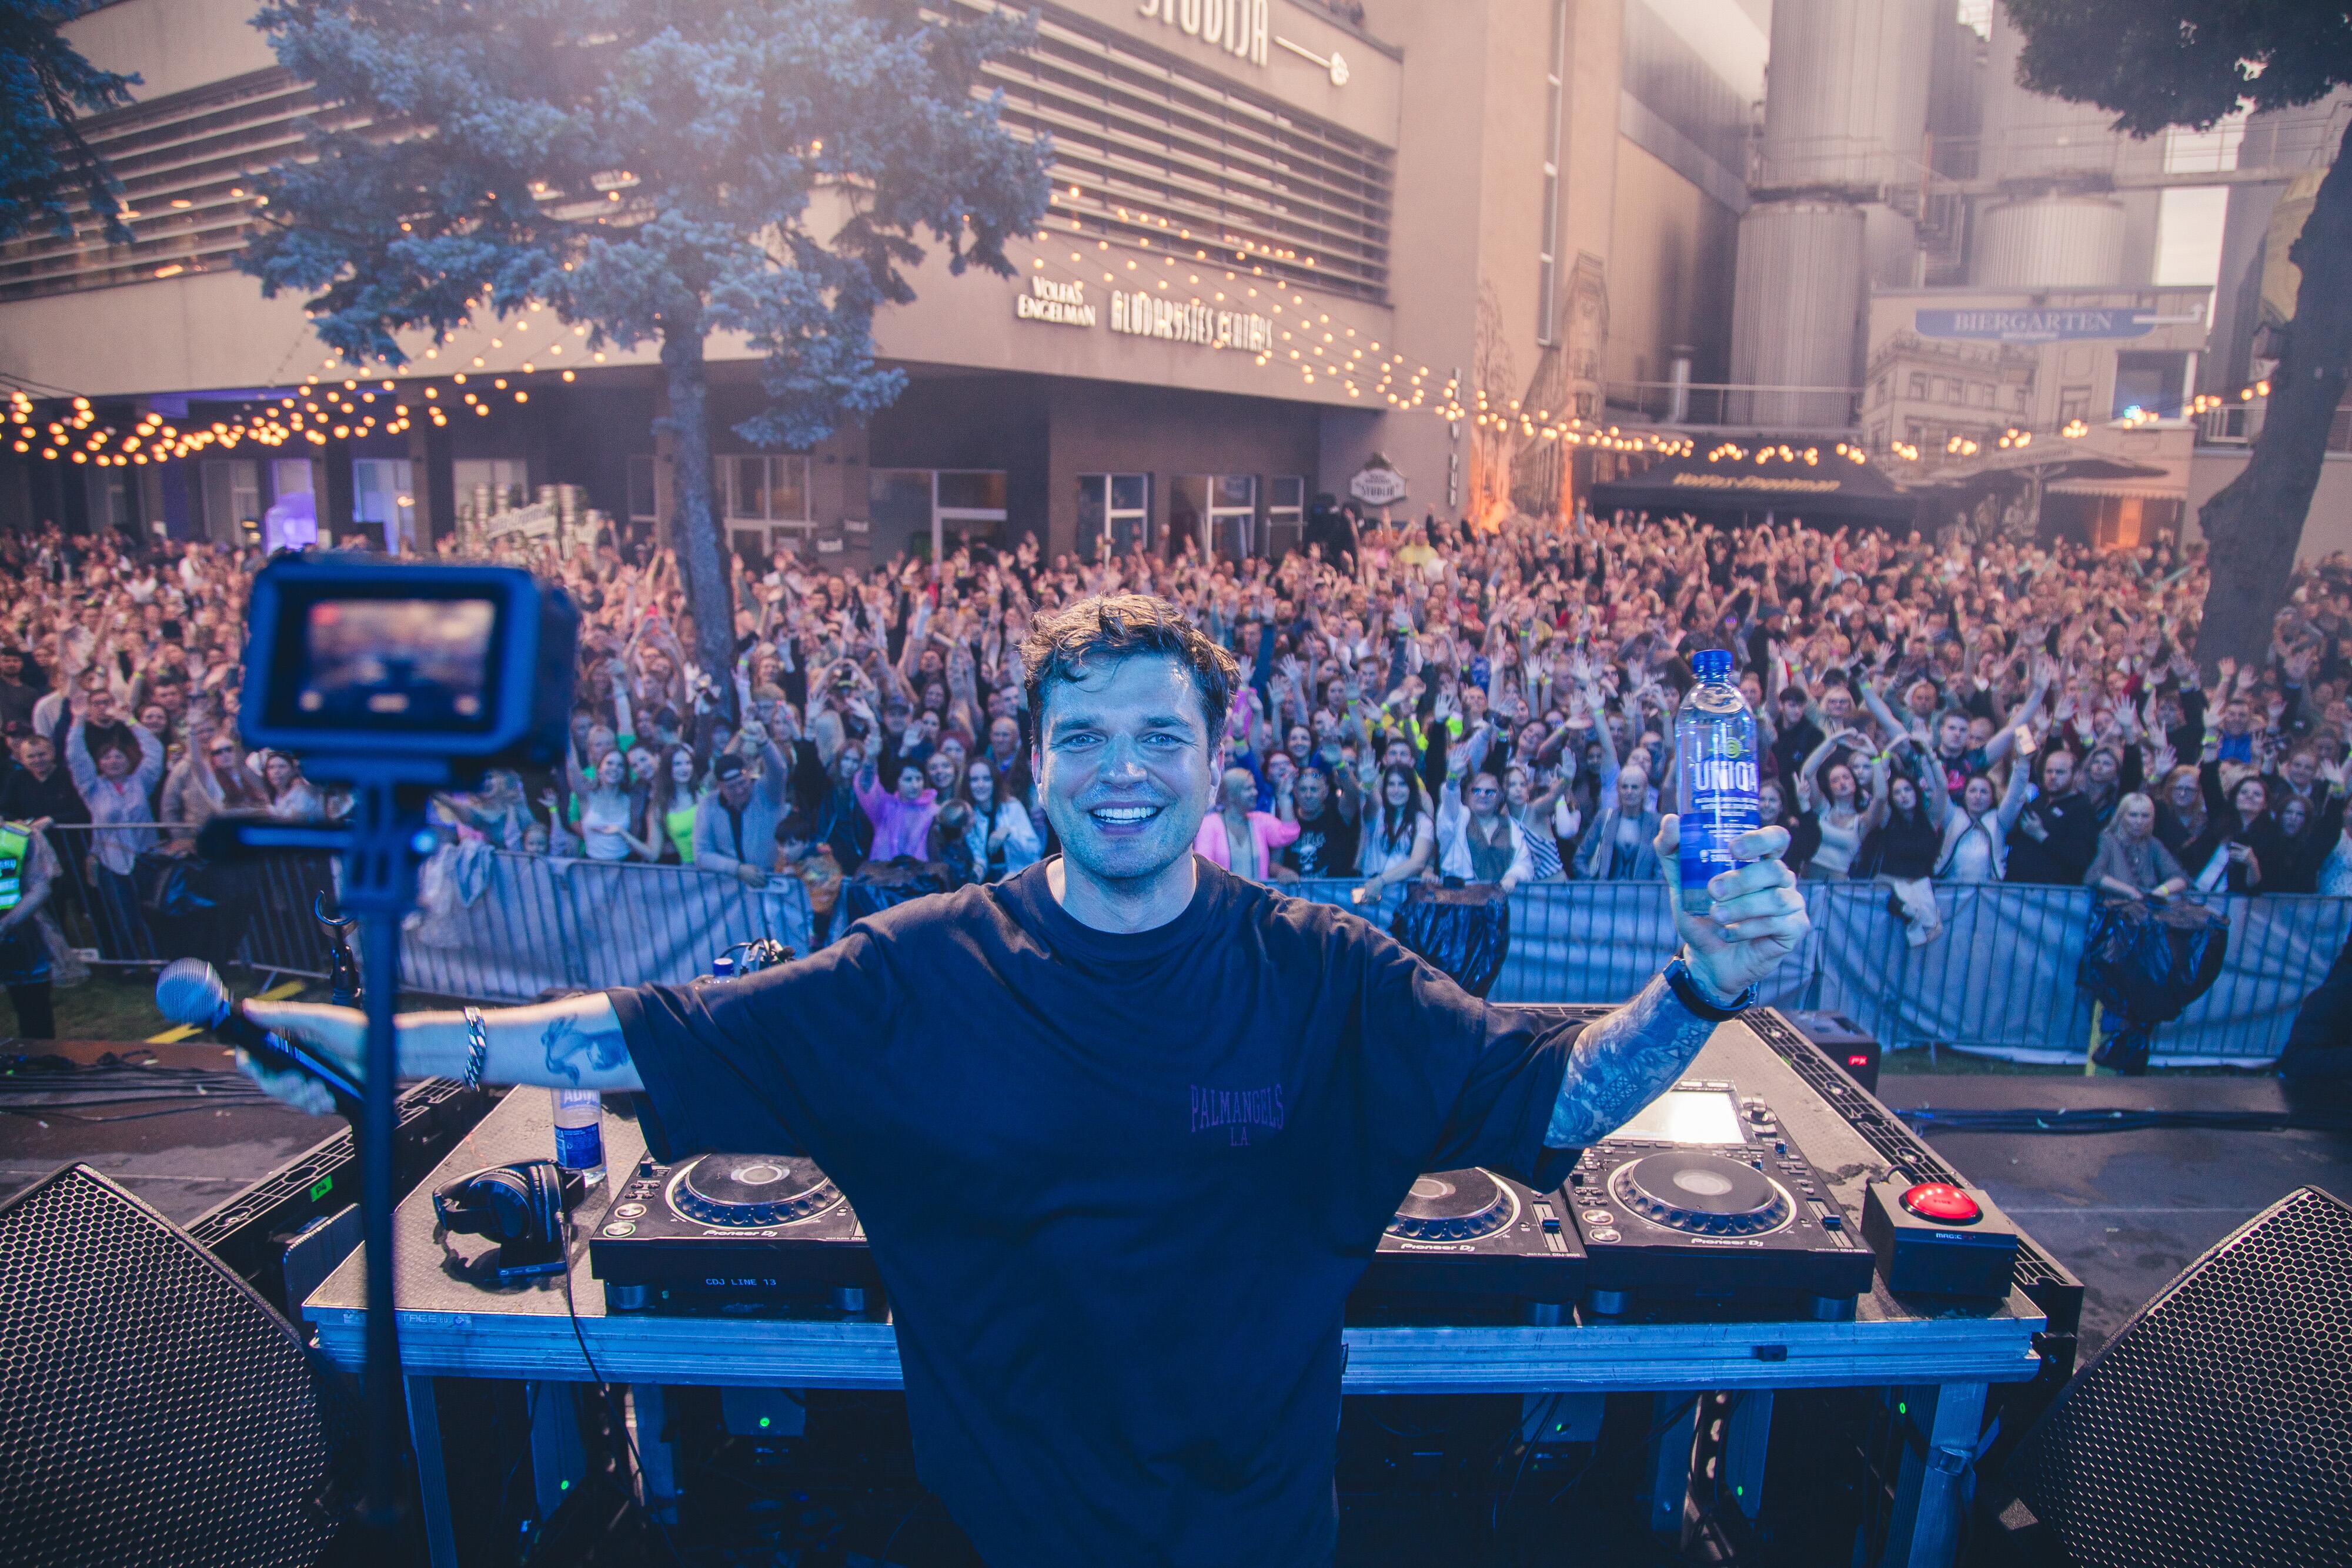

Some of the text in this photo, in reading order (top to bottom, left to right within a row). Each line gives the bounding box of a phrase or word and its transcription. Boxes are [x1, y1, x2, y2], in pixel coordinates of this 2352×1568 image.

[1139, 0, 1268, 66] DIJA
[1032, 275, 1084, 305] VOLFAS
[1018, 294, 1095, 327] ENGELMAN
[1954, 311, 2112, 331] BIERGARTEN
[1695, 760, 1759, 793] UNIQA
